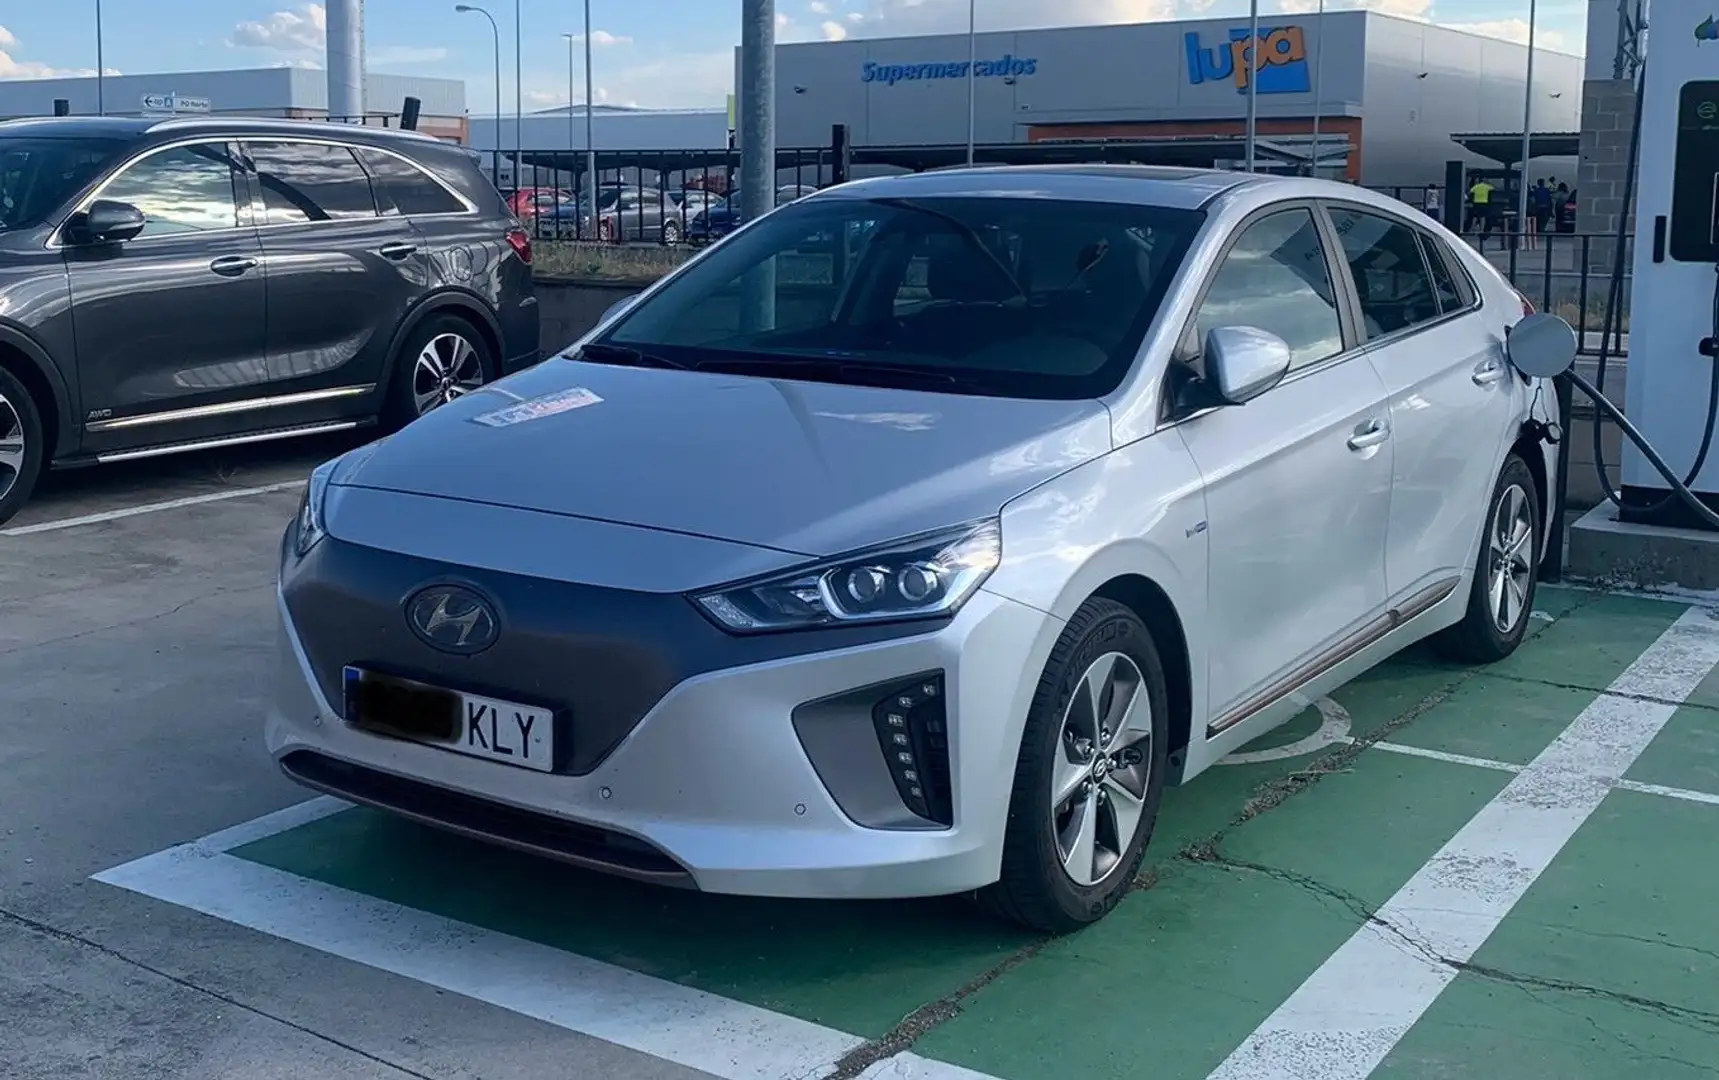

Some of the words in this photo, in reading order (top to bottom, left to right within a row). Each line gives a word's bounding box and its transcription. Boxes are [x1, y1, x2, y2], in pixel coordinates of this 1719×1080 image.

[861, 54, 1038, 86] Supermercados
[1184, 26, 1306, 90] lupa
[87, 408, 112, 420] AWD
[468, 702, 535, 758] KLY
